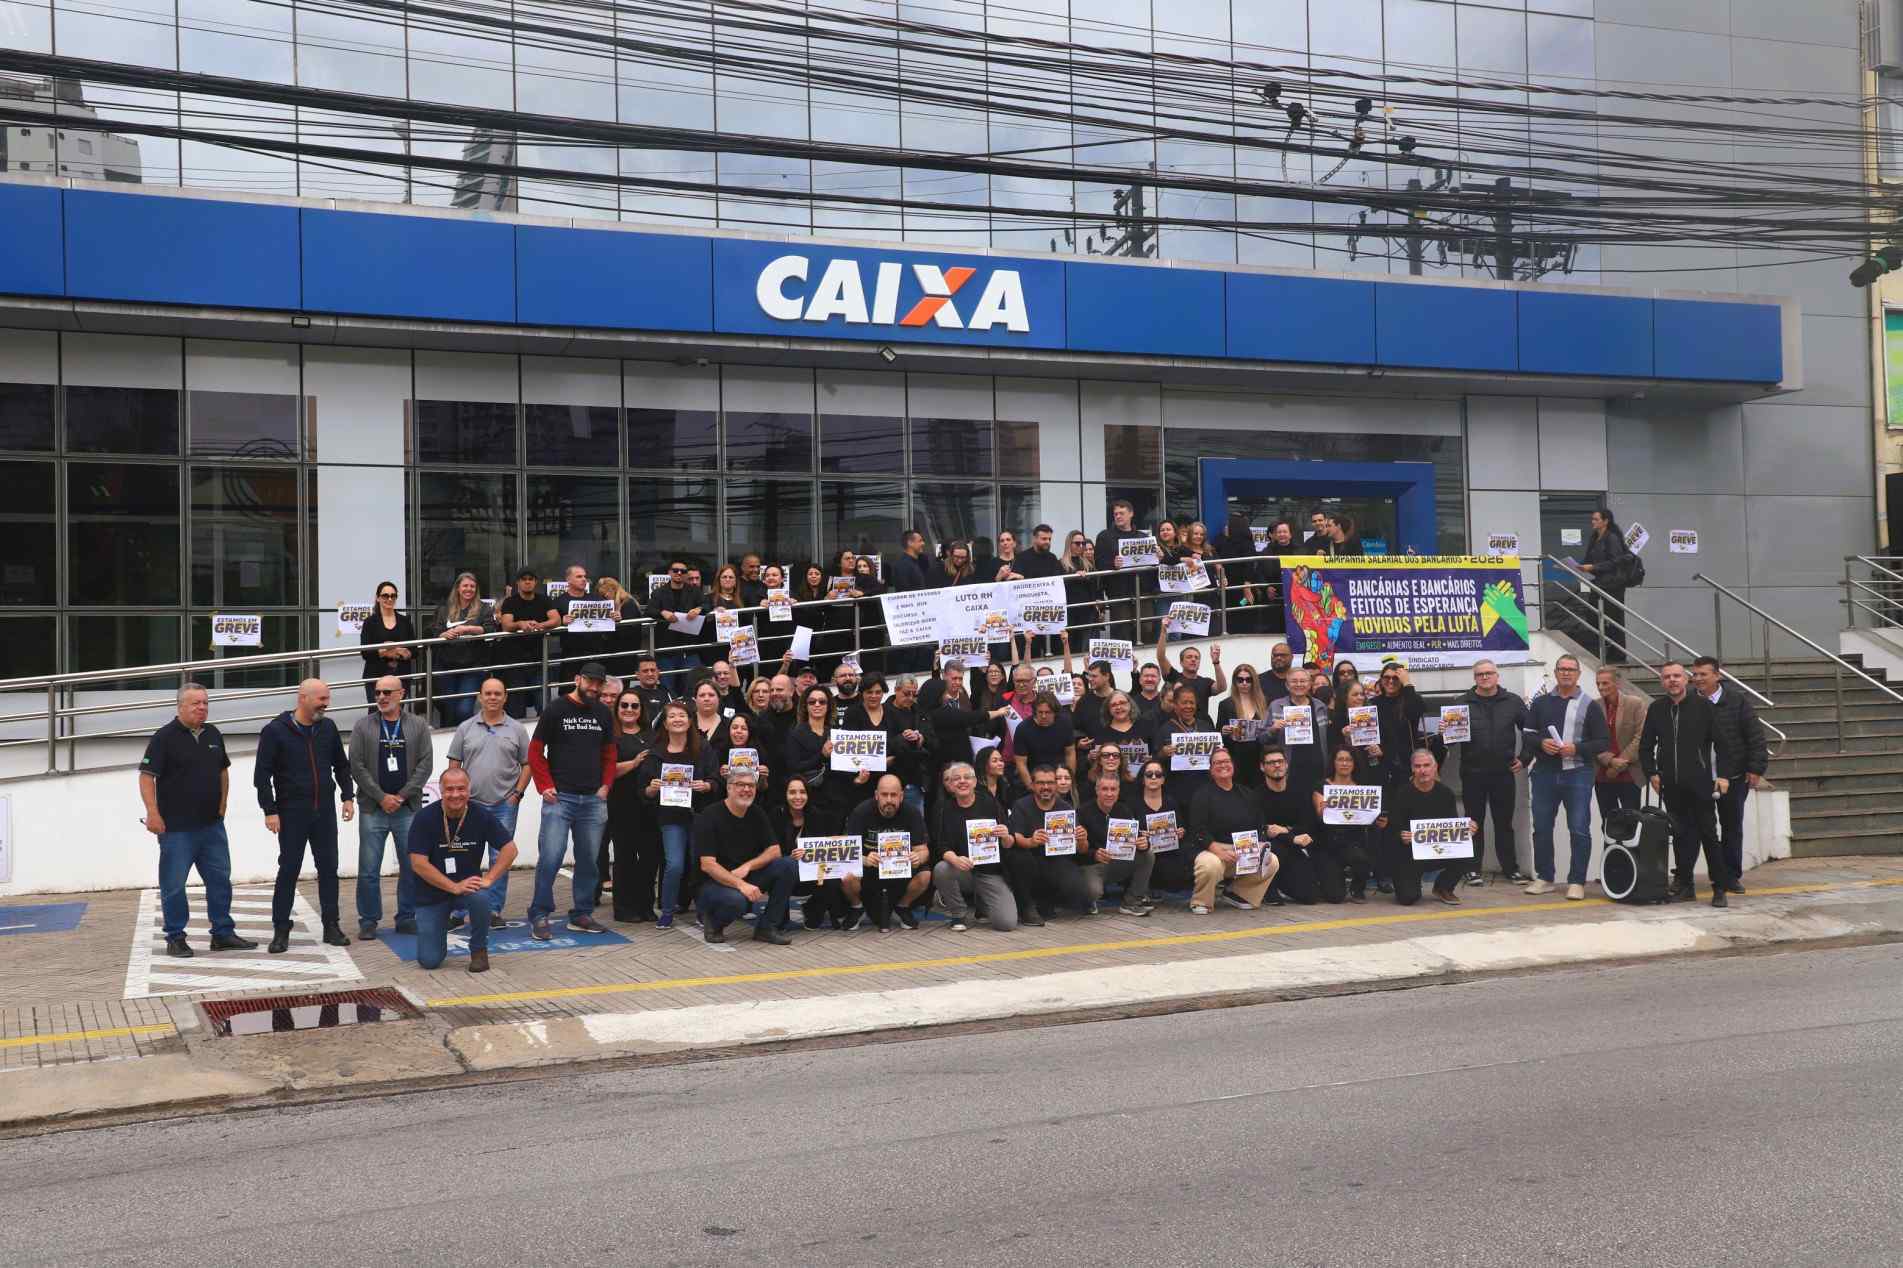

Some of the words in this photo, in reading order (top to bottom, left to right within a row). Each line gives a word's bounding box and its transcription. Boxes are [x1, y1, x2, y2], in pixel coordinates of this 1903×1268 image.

[756, 255, 1030, 332] CAIXA
[1489, 540, 1517, 549] GREVE
[1671, 536, 1697, 545] GREVE
[1121, 544, 1158, 557] GREVE
[1159, 570, 1186, 581] GREV
[1349, 576, 1410, 597] BANCÁRIAS
[1411, 580, 1418, 596] E
[1420, 575, 1477, 596] BANCÁRIOS
[955, 593, 978, 602] LUTO
[980, 591, 993, 600] RH
[572, 602, 599, 610] ESTAMOS
[600, 601, 612, 610] EM
[965, 603, 989, 612] CAIXA
[1172, 603, 1198, 611] ESTAMOS
[1350, 597, 1392, 615] FEITOS
[1394, 597, 1411, 615] DE
[1413, 596, 1479, 615] ESPERANÇA
[570, 608, 614, 620] GREVE
[1023, 610, 1065, 622] GREVE
[1168, 609, 1209, 624] GREVE
[214, 622, 259, 634] GREVE
[1353, 616, 1412, 634] MOVIDOS
[1414, 615, 1446, 633] PELA
[1447, 615, 1479, 633] LUTA
[974, 636, 985, 644] EM
[1387, 640, 1411, 649] AUMENTO
[1412, 640, 1425, 649] REAL
[1431, 640, 1442, 648] PLR
[1447, 640, 1460, 649] MAIS
[1460, 640, 1483, 649] DIREITOS
[941, 643, 987, 656] GREVE
[1091, 646, 1132, 659] GREVE
[1408, 656, 1440, 664] SINDICATO
[1038, 681, 1071, 693] REVE
[578, 716, 592, 724] Cave
[1176, 735, 1208, 743] ESTAMOS
[833, 740, 885, 755] GREVE
[1329, 788, 1365, 796] ESTAMOS
[1326, 795, 1379, 810] GREVE
[1416, 822, 1453, 830] ESTAMOS
[1413, 828, 1470, 844] GREVE
[804, 840, 842, 849] ESTAMOS
[845, 839, 857, 847] EM
[801, 846, 860, 864] GREVE
